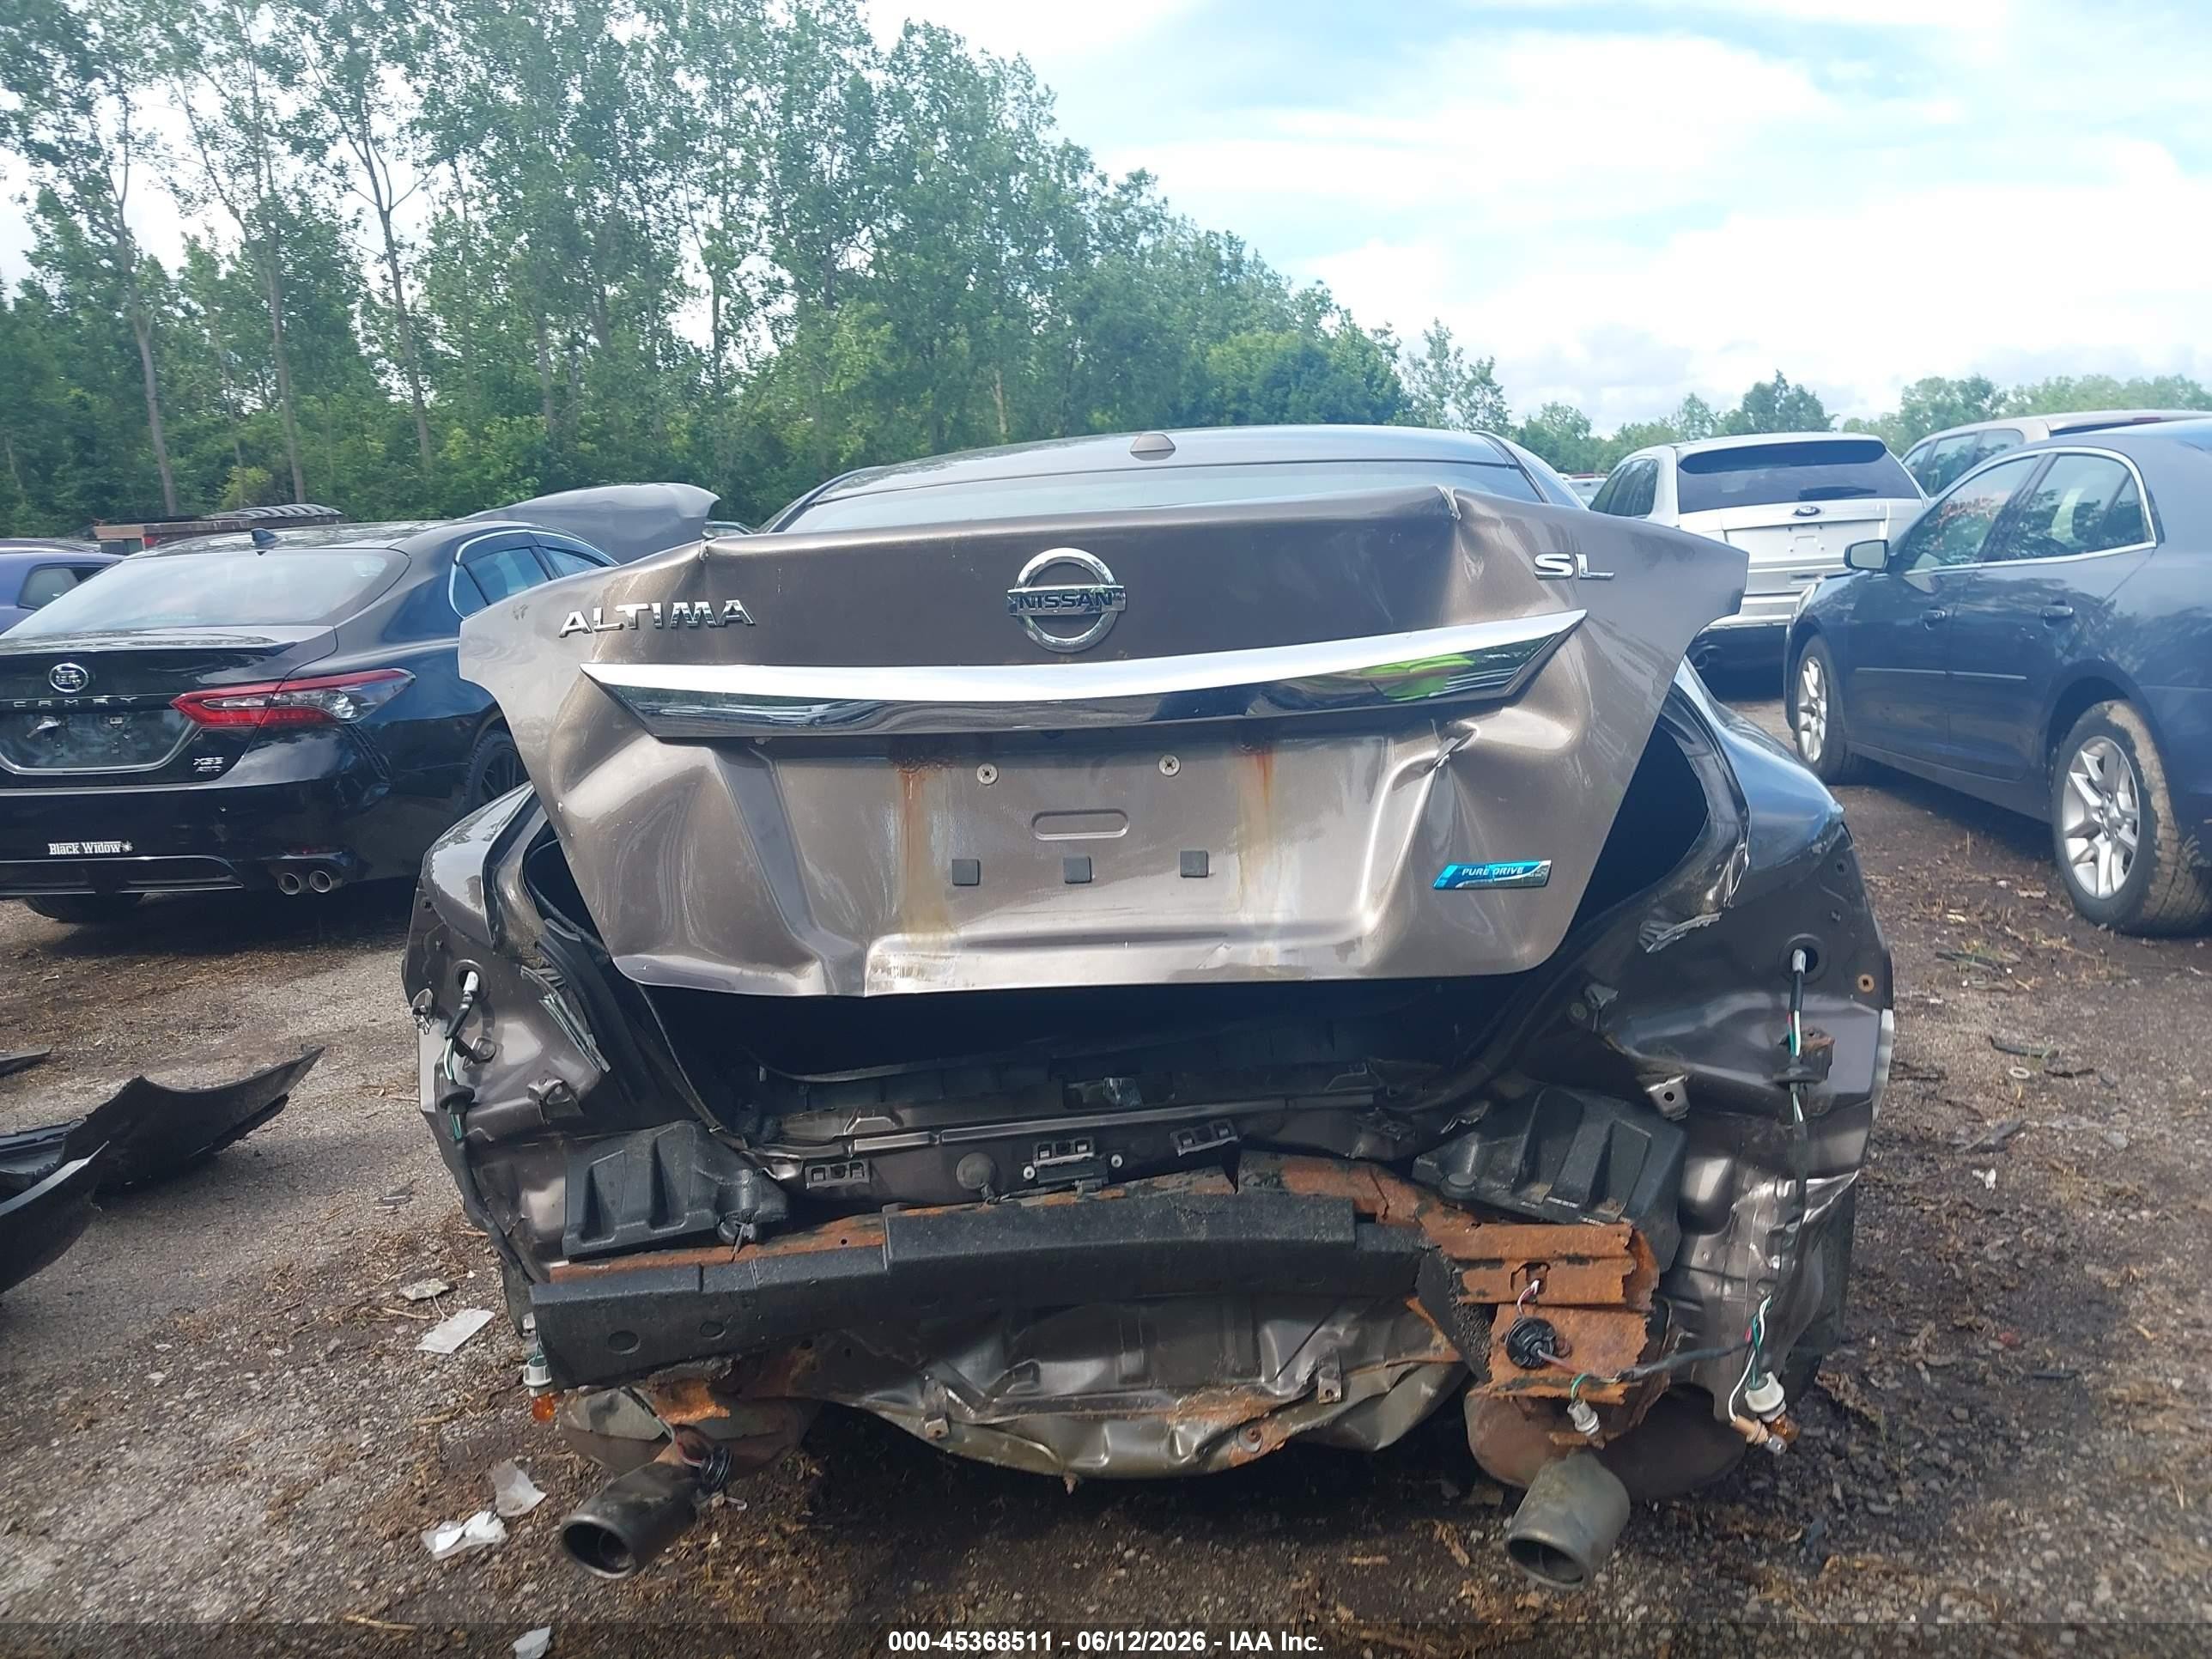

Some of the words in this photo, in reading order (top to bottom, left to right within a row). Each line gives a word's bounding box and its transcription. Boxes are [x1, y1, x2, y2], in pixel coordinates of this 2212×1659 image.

[1534, 553, 1615, 580] SL
[1017, 592, 1113, 609] NISSAN
[558, 599, 757, 638] ALTIMA
[13, 696, 138, 708] CAMRY
[48, 842, 81, 855] Black
[81, 841, 122, 854] Widow
[1462, 867, 1490, 876] PURE
[1492, 866, 1524, 875] DRIVE
